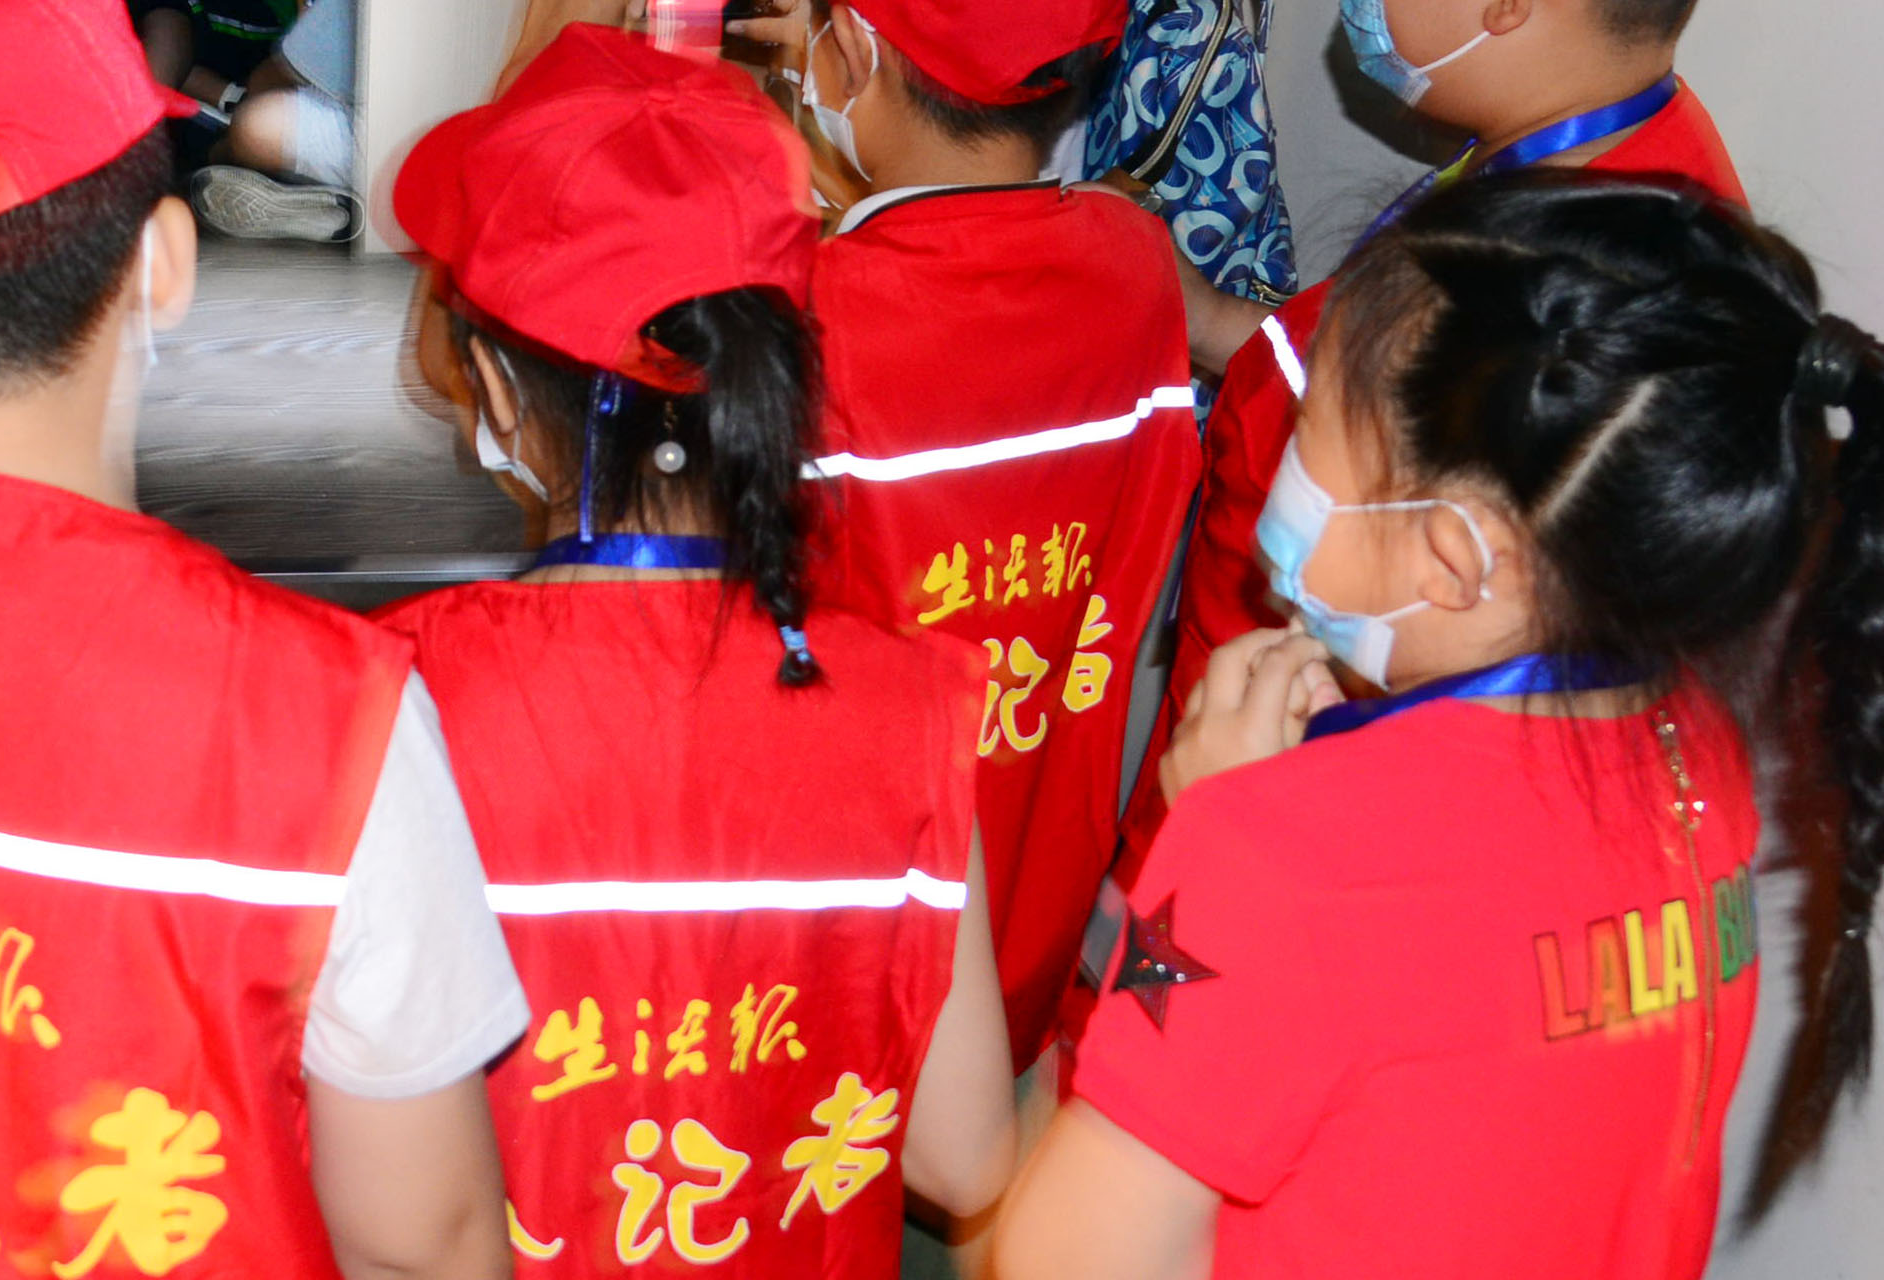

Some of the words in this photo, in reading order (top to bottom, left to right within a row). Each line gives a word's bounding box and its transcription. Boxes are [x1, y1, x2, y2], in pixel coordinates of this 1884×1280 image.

[917, 521, 1093, 625] 生活报
[531, 981, 808, 1103] 生活报
